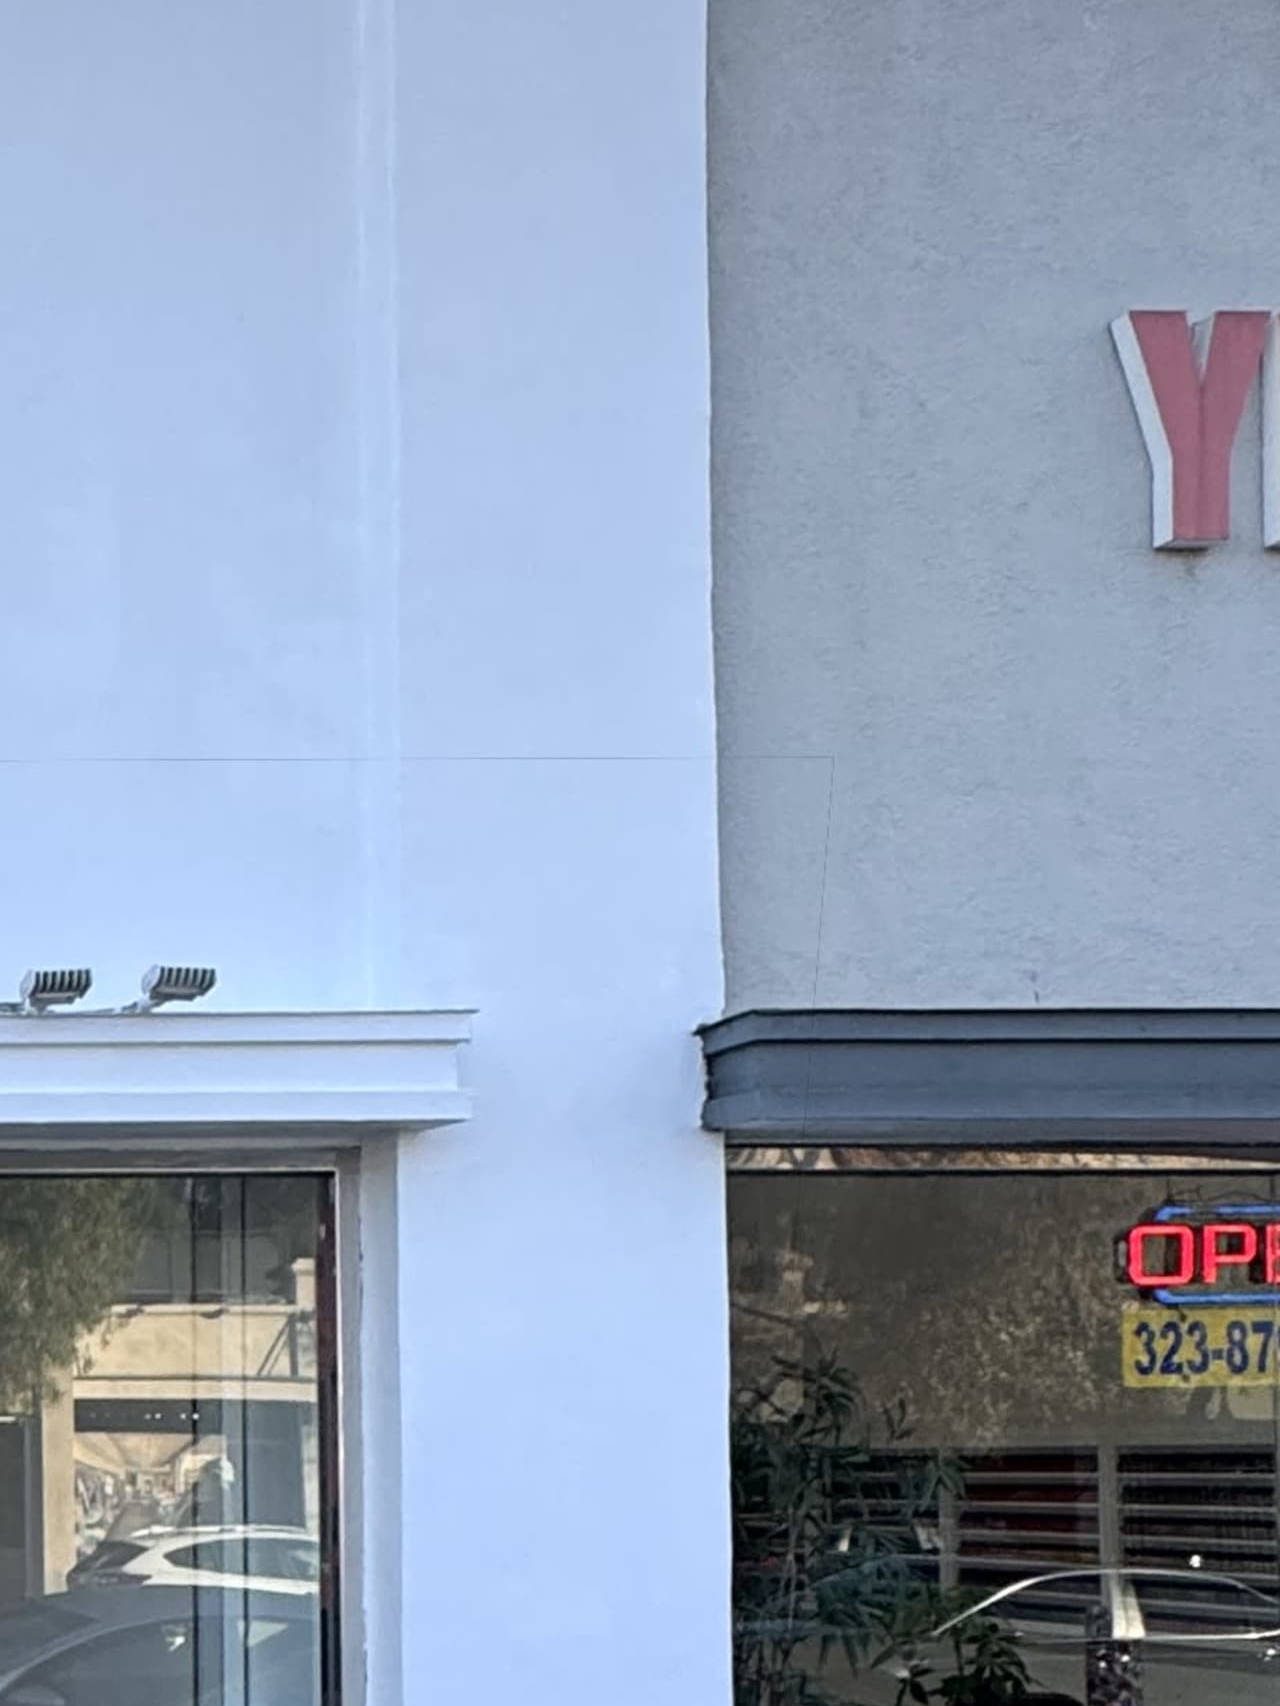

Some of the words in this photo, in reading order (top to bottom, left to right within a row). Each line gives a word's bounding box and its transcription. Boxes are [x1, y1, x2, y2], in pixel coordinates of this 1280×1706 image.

[1110, 309, 1280, 550] Y
[1128, 1224, 1280, 1286] OP
[1133, 1319, 1280, 1376] 323-87
